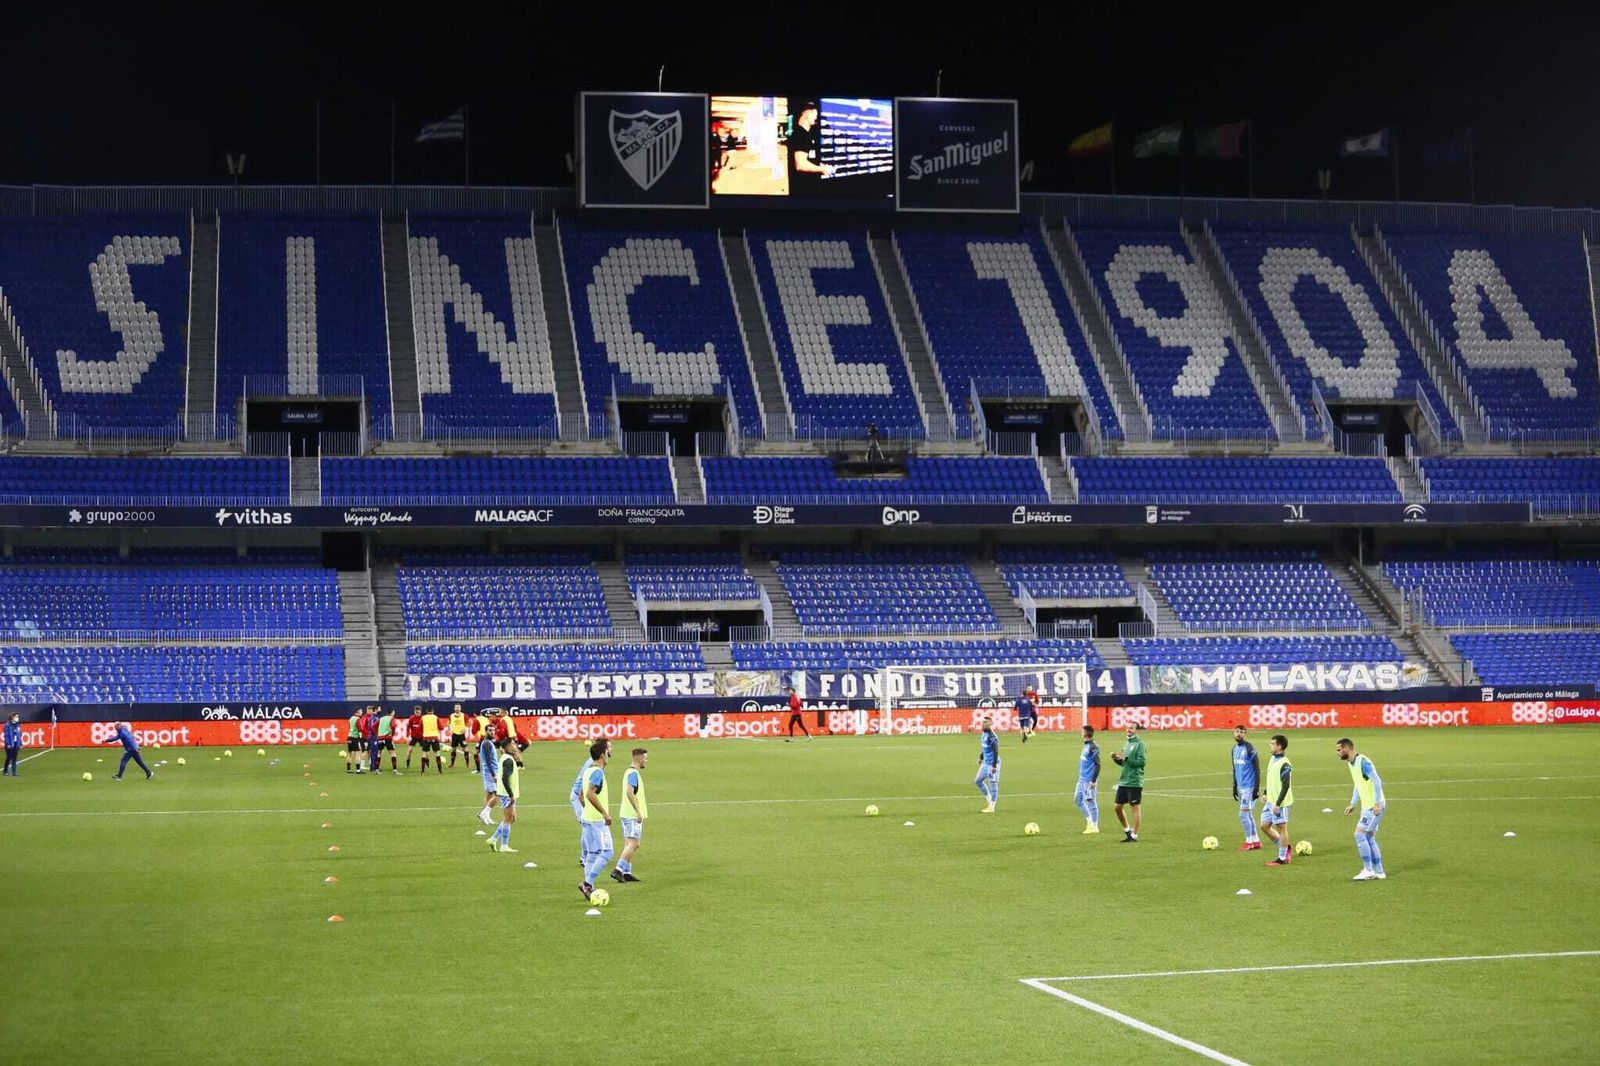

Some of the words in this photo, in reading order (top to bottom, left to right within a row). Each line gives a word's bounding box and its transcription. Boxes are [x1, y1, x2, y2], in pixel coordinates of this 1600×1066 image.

[56, 235, 893, 397] SINCE
[966, 242, 1577, 400] 1904
[234, 509, 292, 525] vithas
[598, 507, 624, 517] DOÑA
[625, 508, 685, 517] FRANCISQUITA
[409, 674, 477, 698] LOS
[491, 676, 536, 698] DE
[550, 673, 715, 698] SIEMPRE
[820, 674, 925, 698] FONDO
[944, 672, 1005, 697] SUR
[1035, 669, 1114, 695] 1904
[1191, 663, 1399, 692] MALAKAS
[1497, 691, 1544, 700] Ayuntamiento
[1555, 690, 1580, 698] Málaga
[242, 704, 303, 719] MÁLAGA
[972, 707, 1065, 732] 888sort
[1249, 704, 1338, 728] 888sport
[1382, 703, 1469, 727] 888sport
[240, 720, 338, 744] 888sport
[536, 715, 636, 740] 888sport
[684, 713, 781, 738] 88sport
